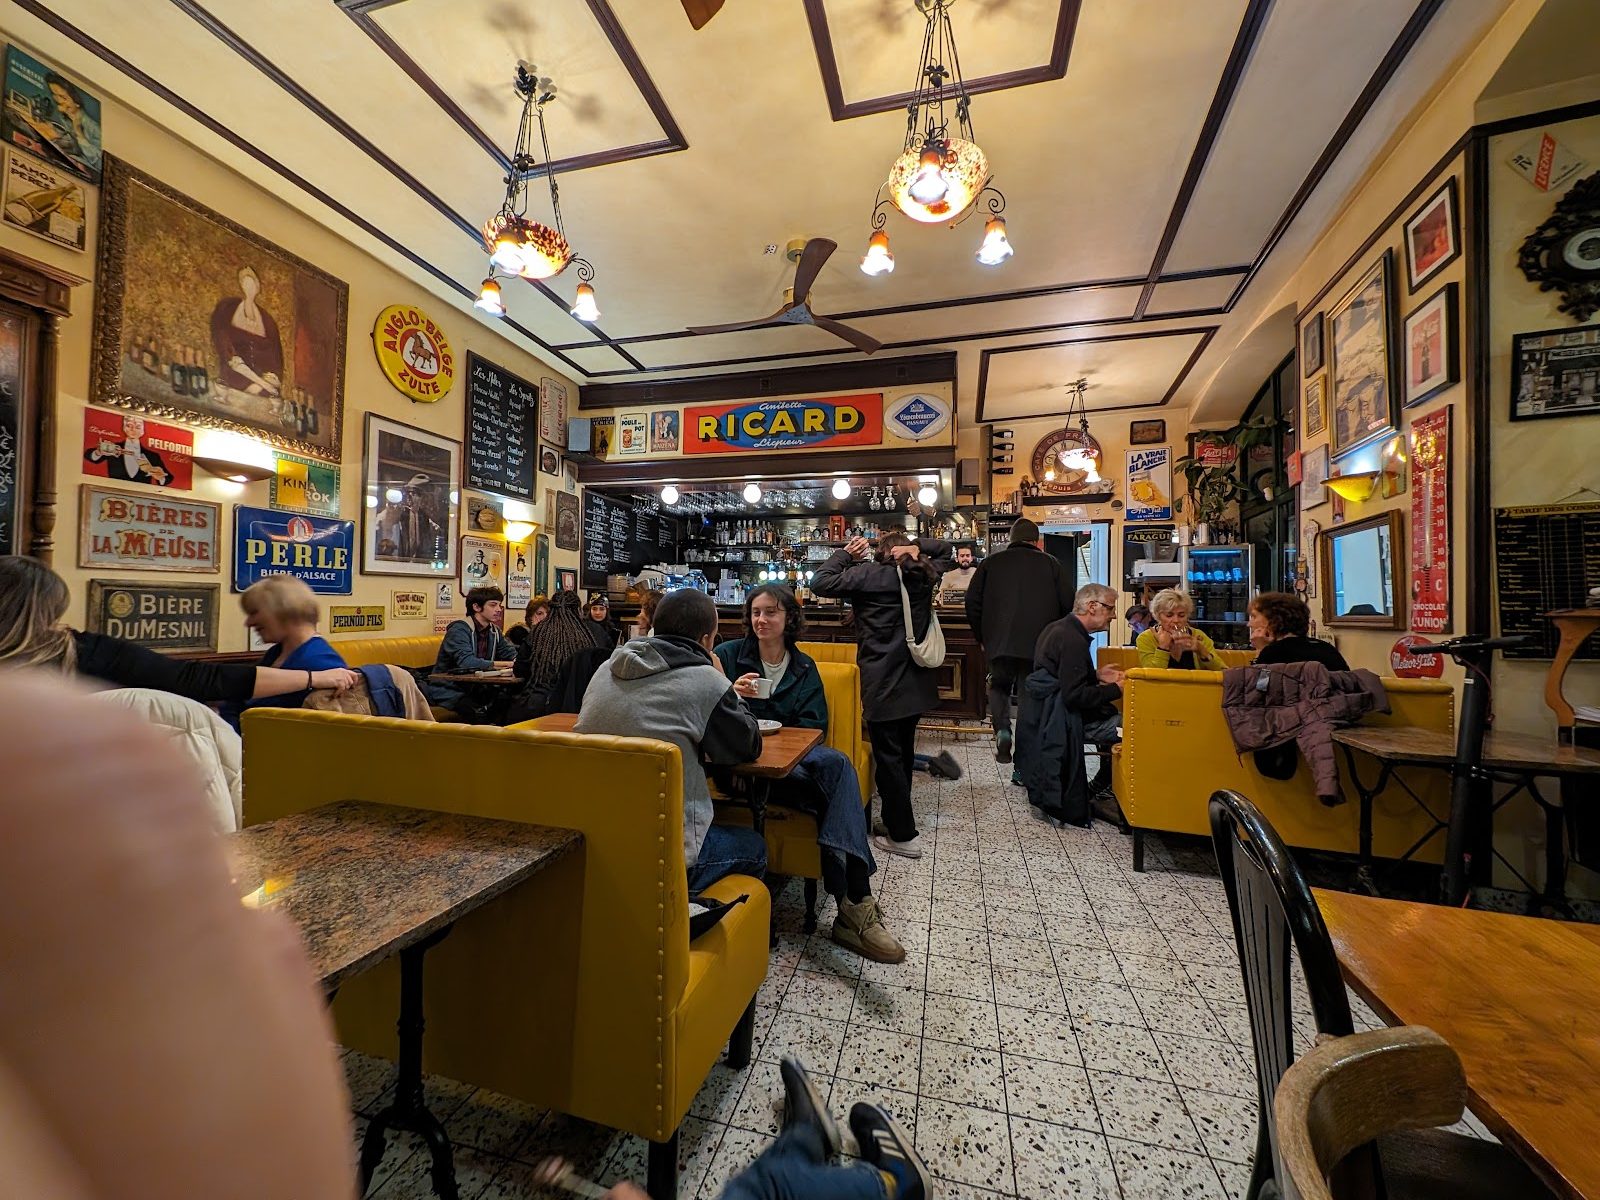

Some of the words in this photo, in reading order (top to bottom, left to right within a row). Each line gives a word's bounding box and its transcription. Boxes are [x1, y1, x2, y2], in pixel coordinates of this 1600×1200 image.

[10, 157, 56, 184] SAMOS
[1536, 139, 1554, 186] LICENCE
[384, 310, 453, 378] ANGLO-BELGE
[398, 370, 441, 395] ZULTE
[698, 405, 860, 440] RICARD
[148, 438, 192, 455] PELFORTH
[754, 438, 805, 448] Liqueur
[1129, 456, 1166, 474] BLANCHE
[1131, 454, 1143, 463] LA
[1145, 450, 1166, 458] VRAIE
[283, 476, 317, 492] KINA
[93, 535, 112, 554] LA
[124, 532, 210, 560] MEUSE
[245, 539, 348, 570] PERLE
[1414, 581, 1420, 591] C
[1436, 579, 1442, 590] C
[140, 593, 203, 615] BIÈRE
[107, 618, 206, 640] DUMESNIL
[333, 615, 365, 628] PERNOD
[367, 614, 383, 626] FILS
